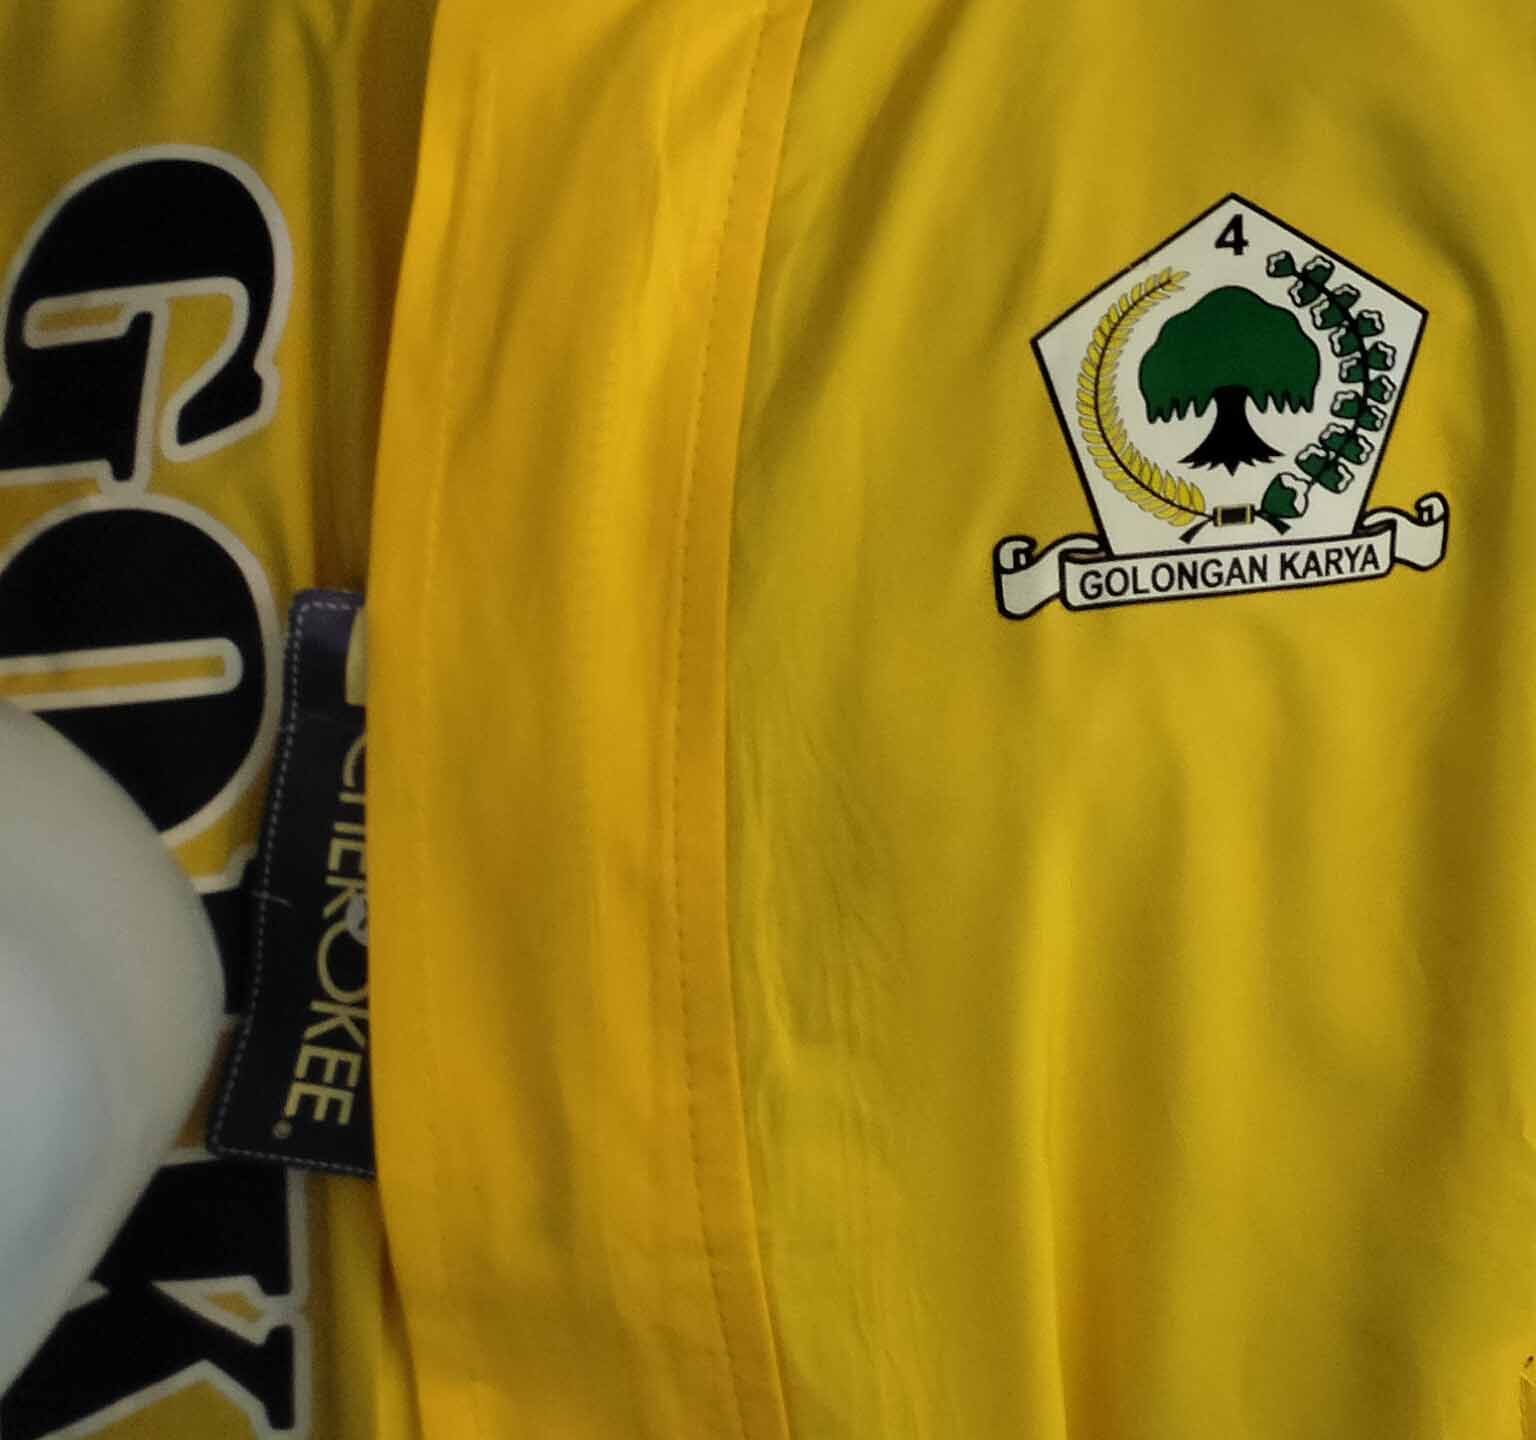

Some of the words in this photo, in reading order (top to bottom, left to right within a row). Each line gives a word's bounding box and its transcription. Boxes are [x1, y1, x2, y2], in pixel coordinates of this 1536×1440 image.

[1214, 213, 1250, 256] 4
[1079, 553, 1268, 601] GOLONGAN
[1279, 543, 1381, 580] KARYA
